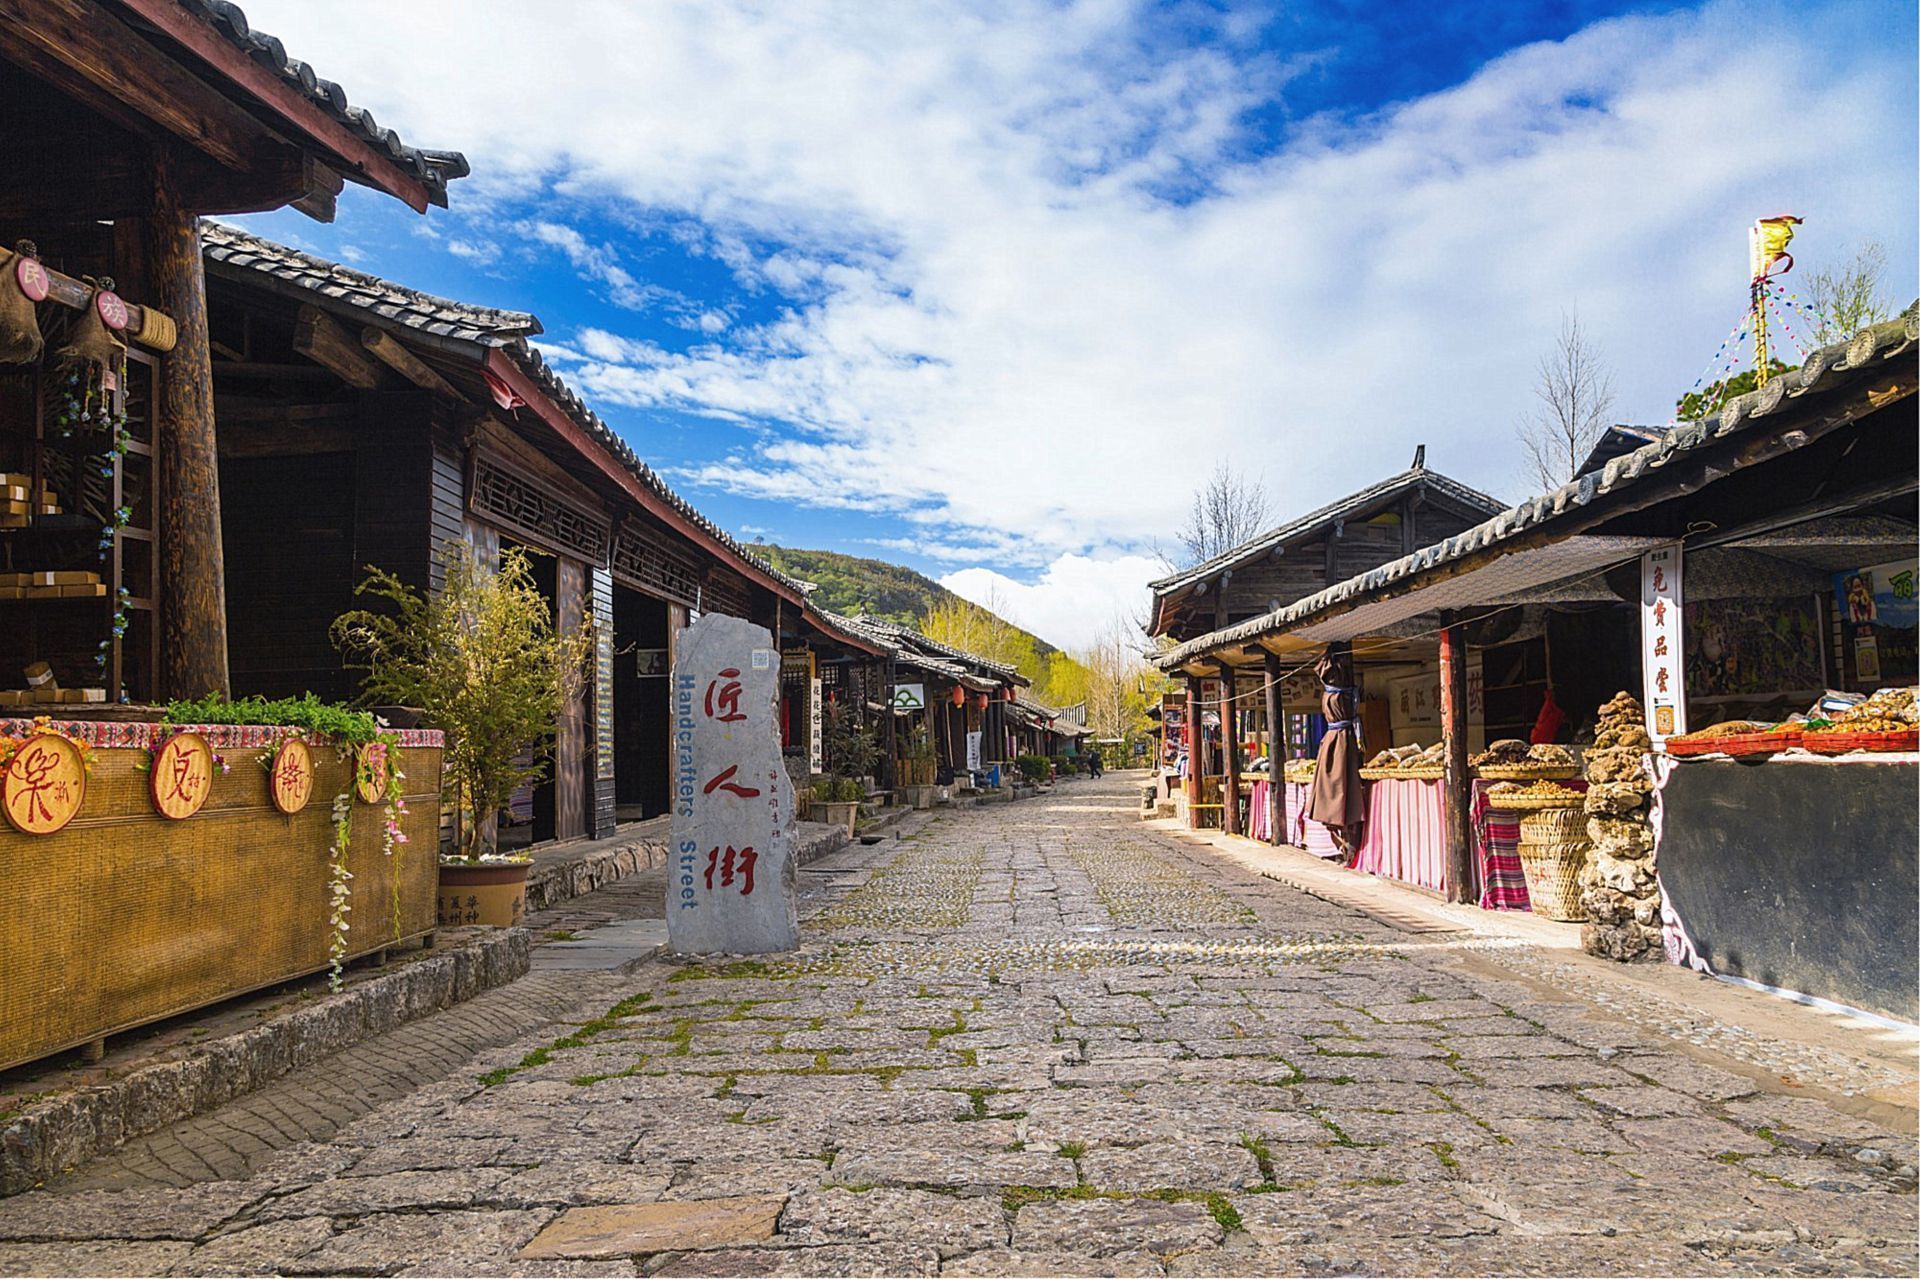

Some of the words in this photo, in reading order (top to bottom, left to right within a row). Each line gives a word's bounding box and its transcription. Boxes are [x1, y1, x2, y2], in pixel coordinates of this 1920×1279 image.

[24, 262, 46, 297] 民
[102, 295, 125, 328] 族
[1888, 569, 1919, 600] 丽
[678, 674, 697, 818] Handcrafters
[703, 667, 760, 896] 匠人街
[679, 840, 699, 910] Street
